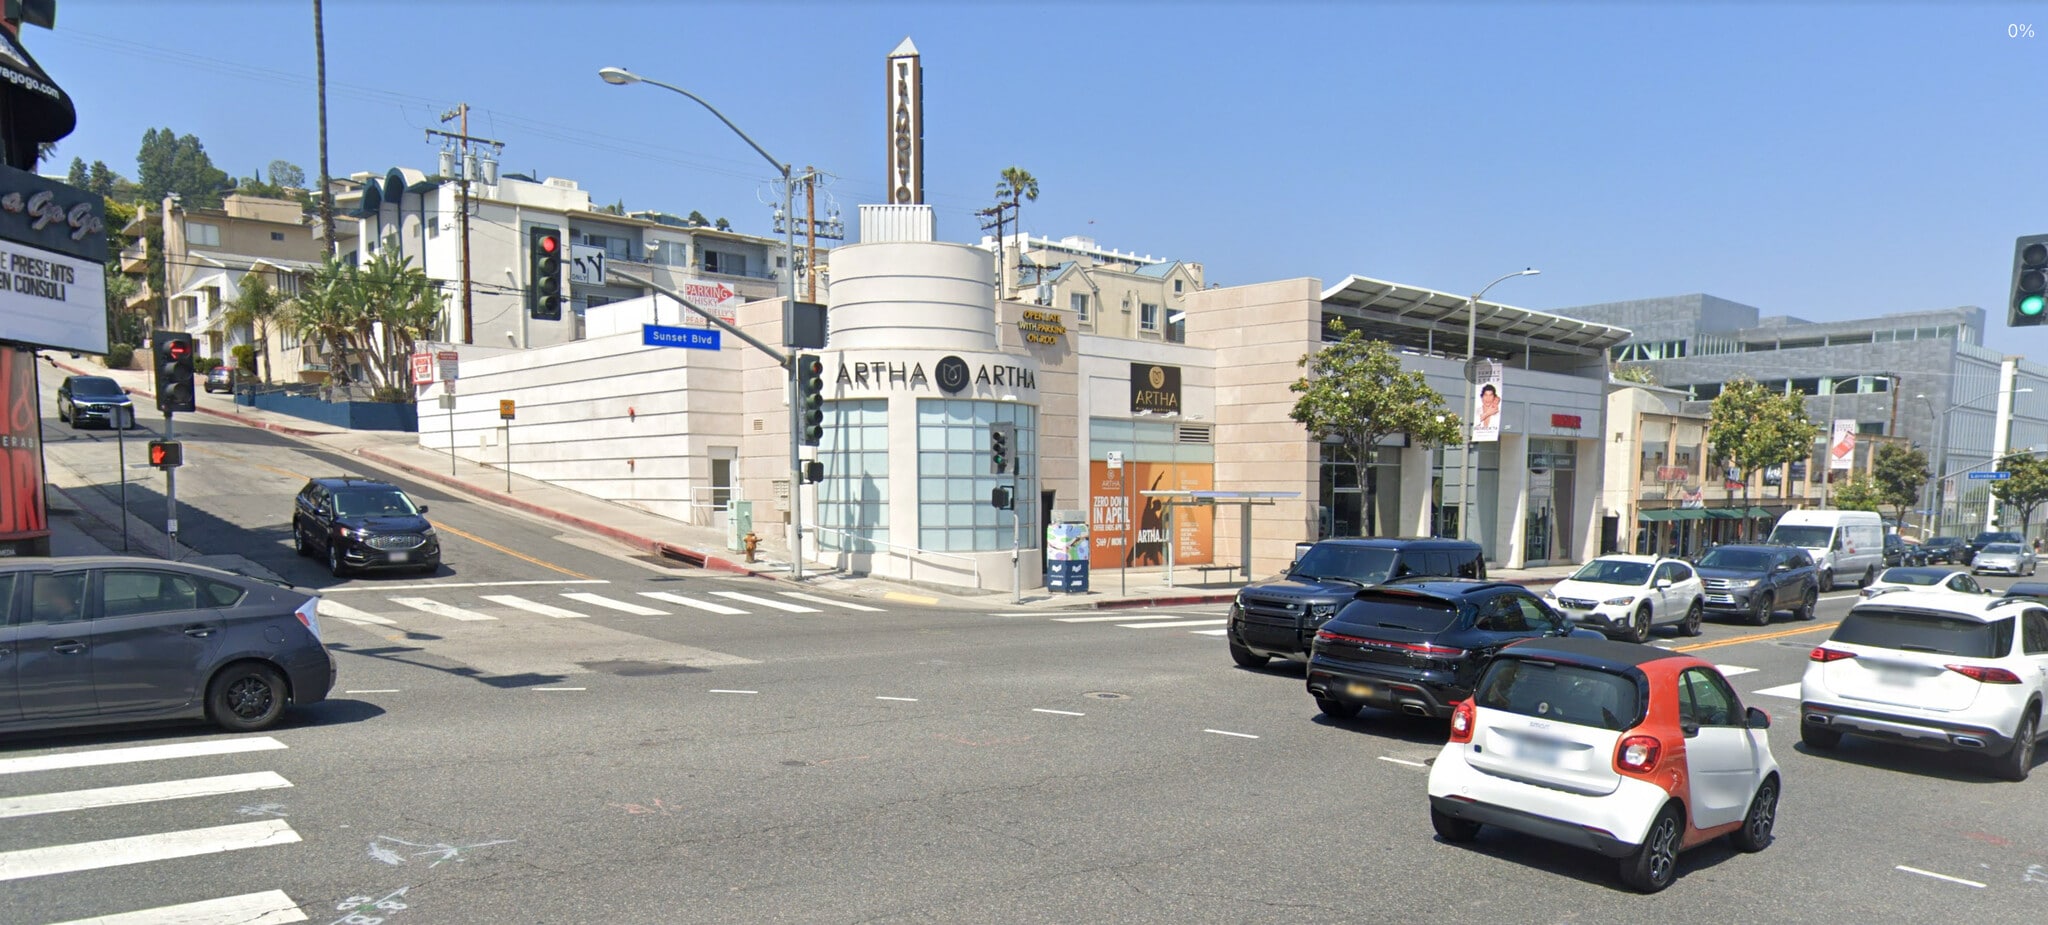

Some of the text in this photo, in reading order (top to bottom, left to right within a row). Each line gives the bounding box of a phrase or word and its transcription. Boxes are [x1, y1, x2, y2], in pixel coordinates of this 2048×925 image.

[0, 66, 60, 99] agogo.com
[11, 253, 75, 285] PRESENTS
[14, 274, 66, 302] CONSOLI
[685, 284, 728, 301] PARKING
[1022, 309, 1043, 321] OPEN
[1017, 321, 1067, 335] WITH PARKING
[653, 331, 713, 345] Sunset Blvd
[836, 361, 1036, 389] ARTHA ARTHA
[1135, 390, 1178, 408] ARTHA
[1093, 496, 1109, 507] ZERO
[1093, 507, 1103, 524] IN
